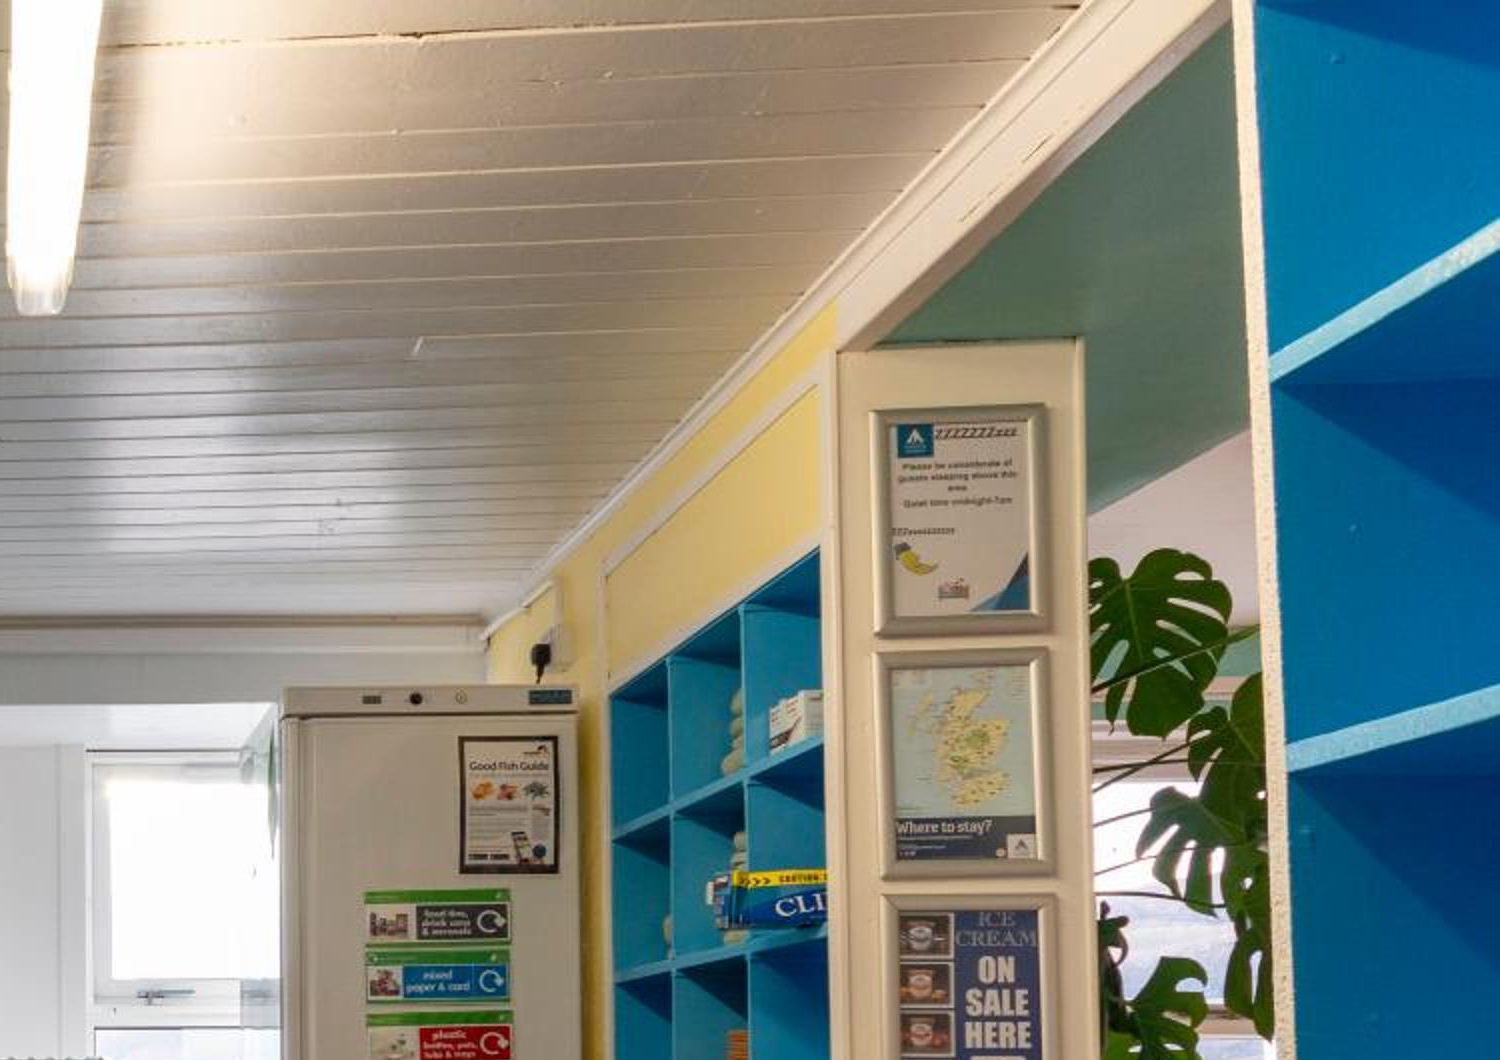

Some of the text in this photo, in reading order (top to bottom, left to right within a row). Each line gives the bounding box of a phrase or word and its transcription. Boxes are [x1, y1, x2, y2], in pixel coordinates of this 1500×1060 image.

[946, 460, 1001, 470] considerate
[931, 473, 969, 483] sleeping
[469, 761, 549, 770] Good Fish Guide
[896, 819, 993, 836] Where to stay?
[978, 911, 1016, 927] ICE
[956, 929, 1037, 948] CREAM
[422, 969, 453, 981] mixed
[977, 955, 1016, 983] ON
[406, 981, 471, 995] paper & card
[965, 988, 1030, 1017] SALE
[432, 1029, 468, 1041] plastic
[964, 1021, 1033, 1049] HERE
